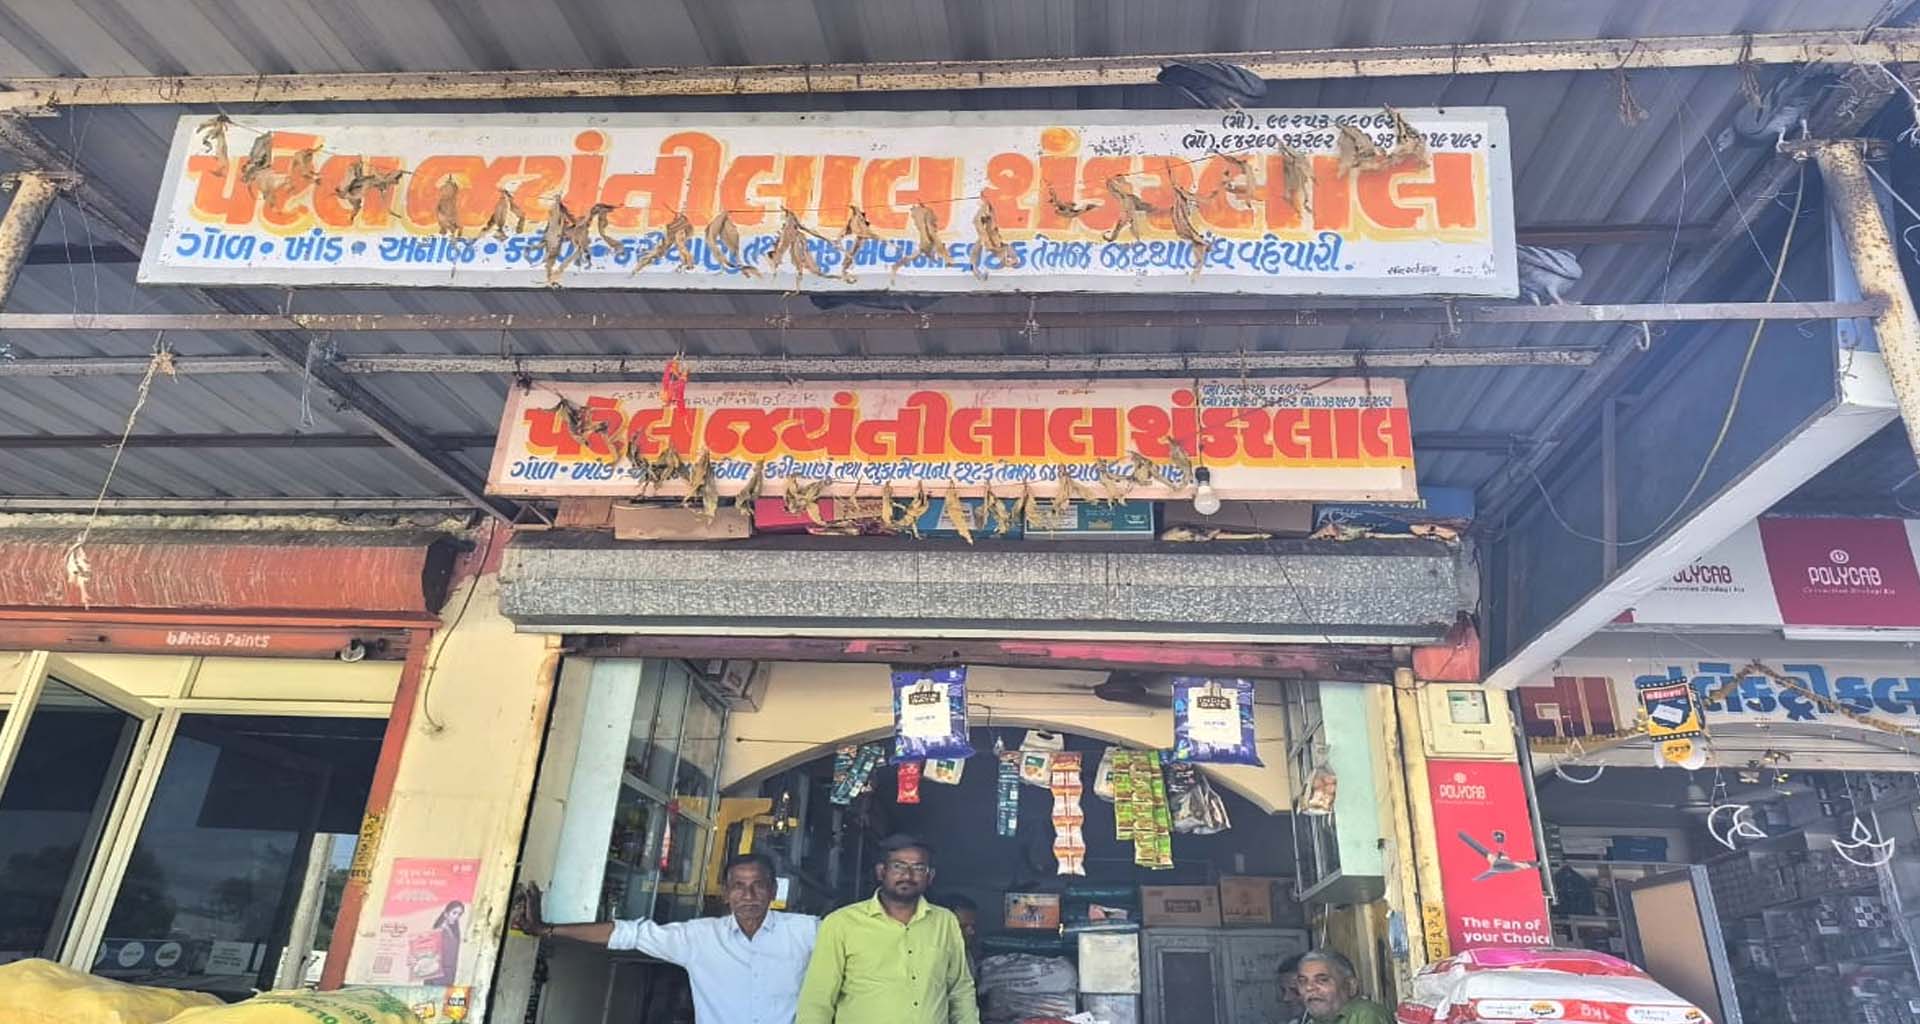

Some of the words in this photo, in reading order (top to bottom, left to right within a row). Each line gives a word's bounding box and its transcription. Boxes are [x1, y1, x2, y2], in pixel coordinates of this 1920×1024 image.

[187, 131, 401, 226] પટેલ
[406, 128, 957, 229] જયંતીલાલ
[984, 127, 1475, 230] શંકરલાલ
[525, 396, 697, 456] પટેલ
[704, 389, 1118, 458] જયંતીલાલ
[1128, 388, 1413, 460] શંકરલાલ
[1672, 564, 1733, 585] LYCAB
[1808, 566, 1882, 587] POLYCAB
[223, 632, 272, 648] Paints
[1439, 784, 1486, 800] POLYCAB
[1461, 916, 1491, 929] The
[1493, 917, 1521, 930] Fan
[1524, 918, 1542, 931] of
[1463, 931, 1499, 944] your
